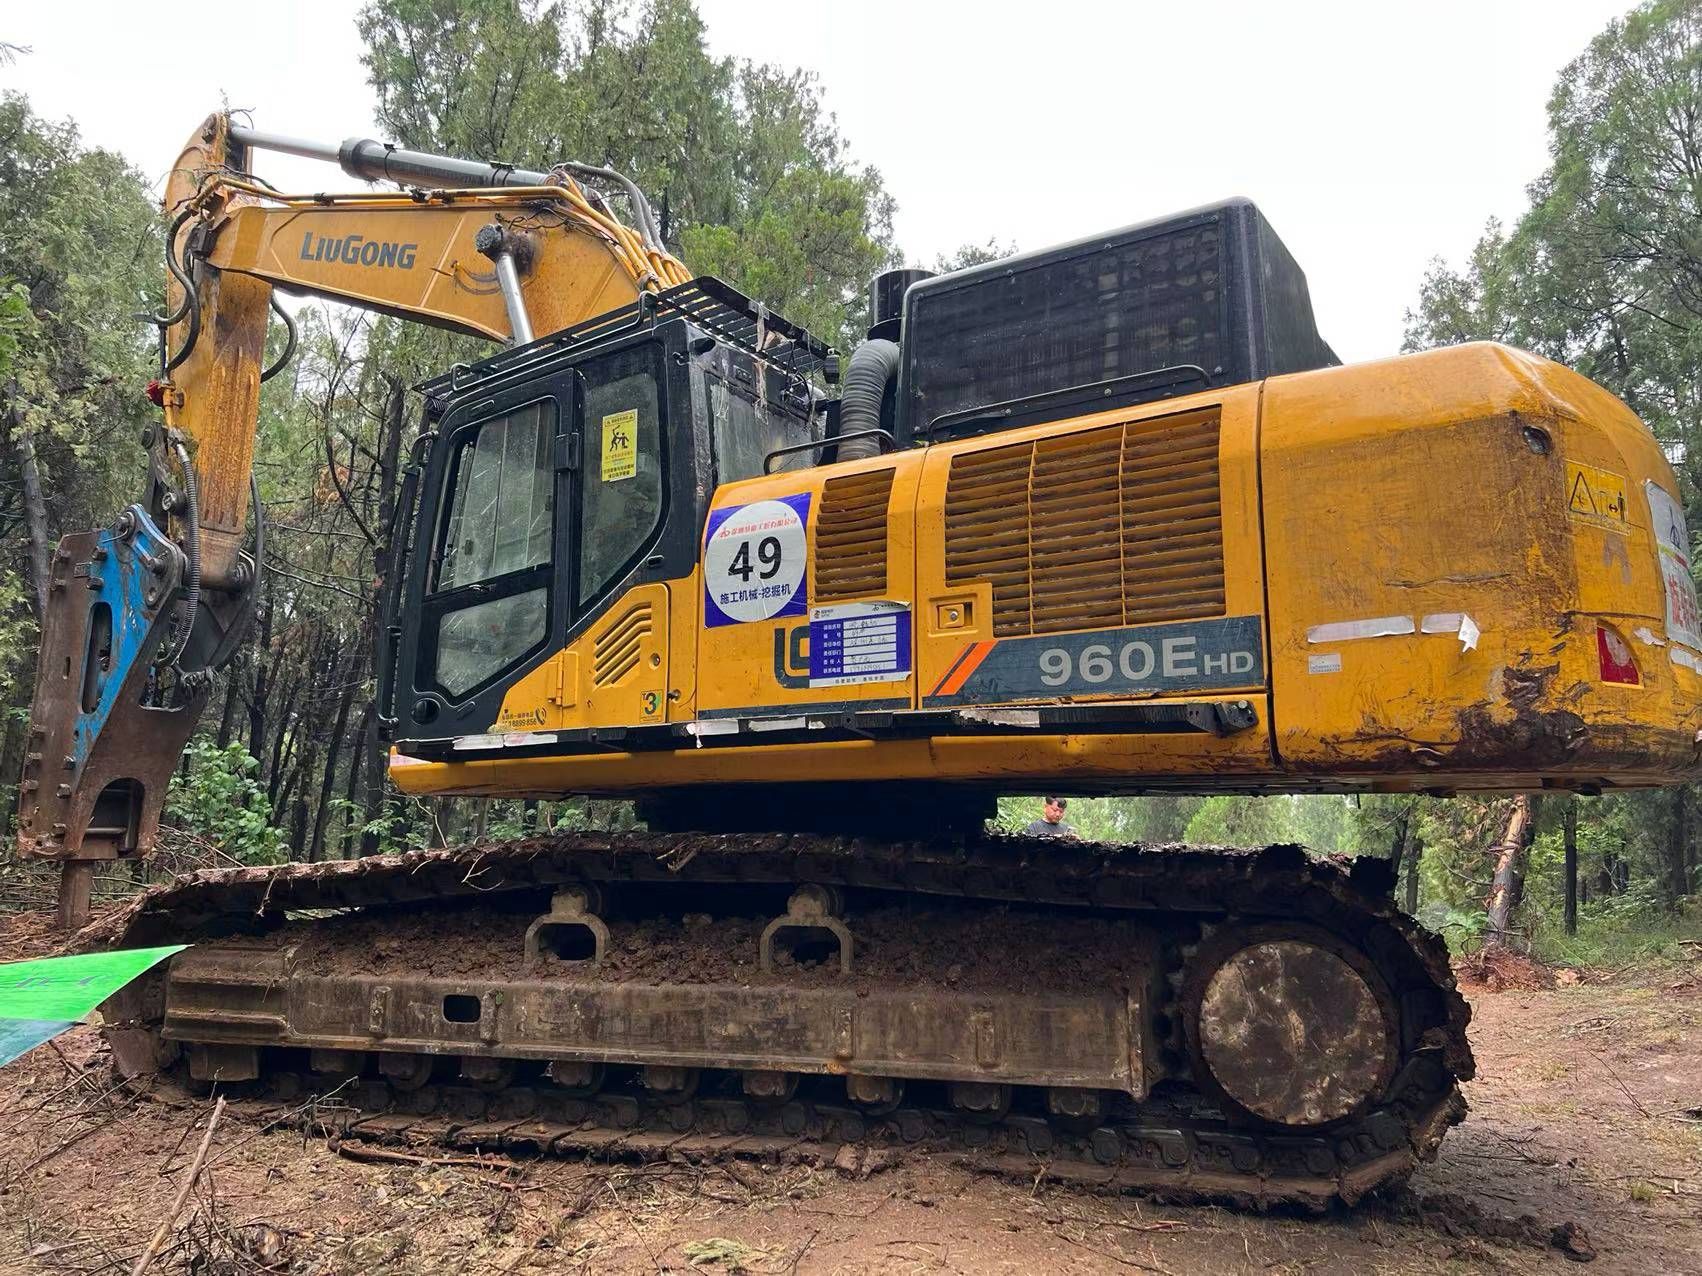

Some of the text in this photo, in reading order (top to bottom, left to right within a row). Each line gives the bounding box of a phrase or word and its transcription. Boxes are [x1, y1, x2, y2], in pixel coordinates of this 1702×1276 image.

[728, 536, 783, 582] 49
[720, 583, 792, 605] 施工机械-挖掘机
